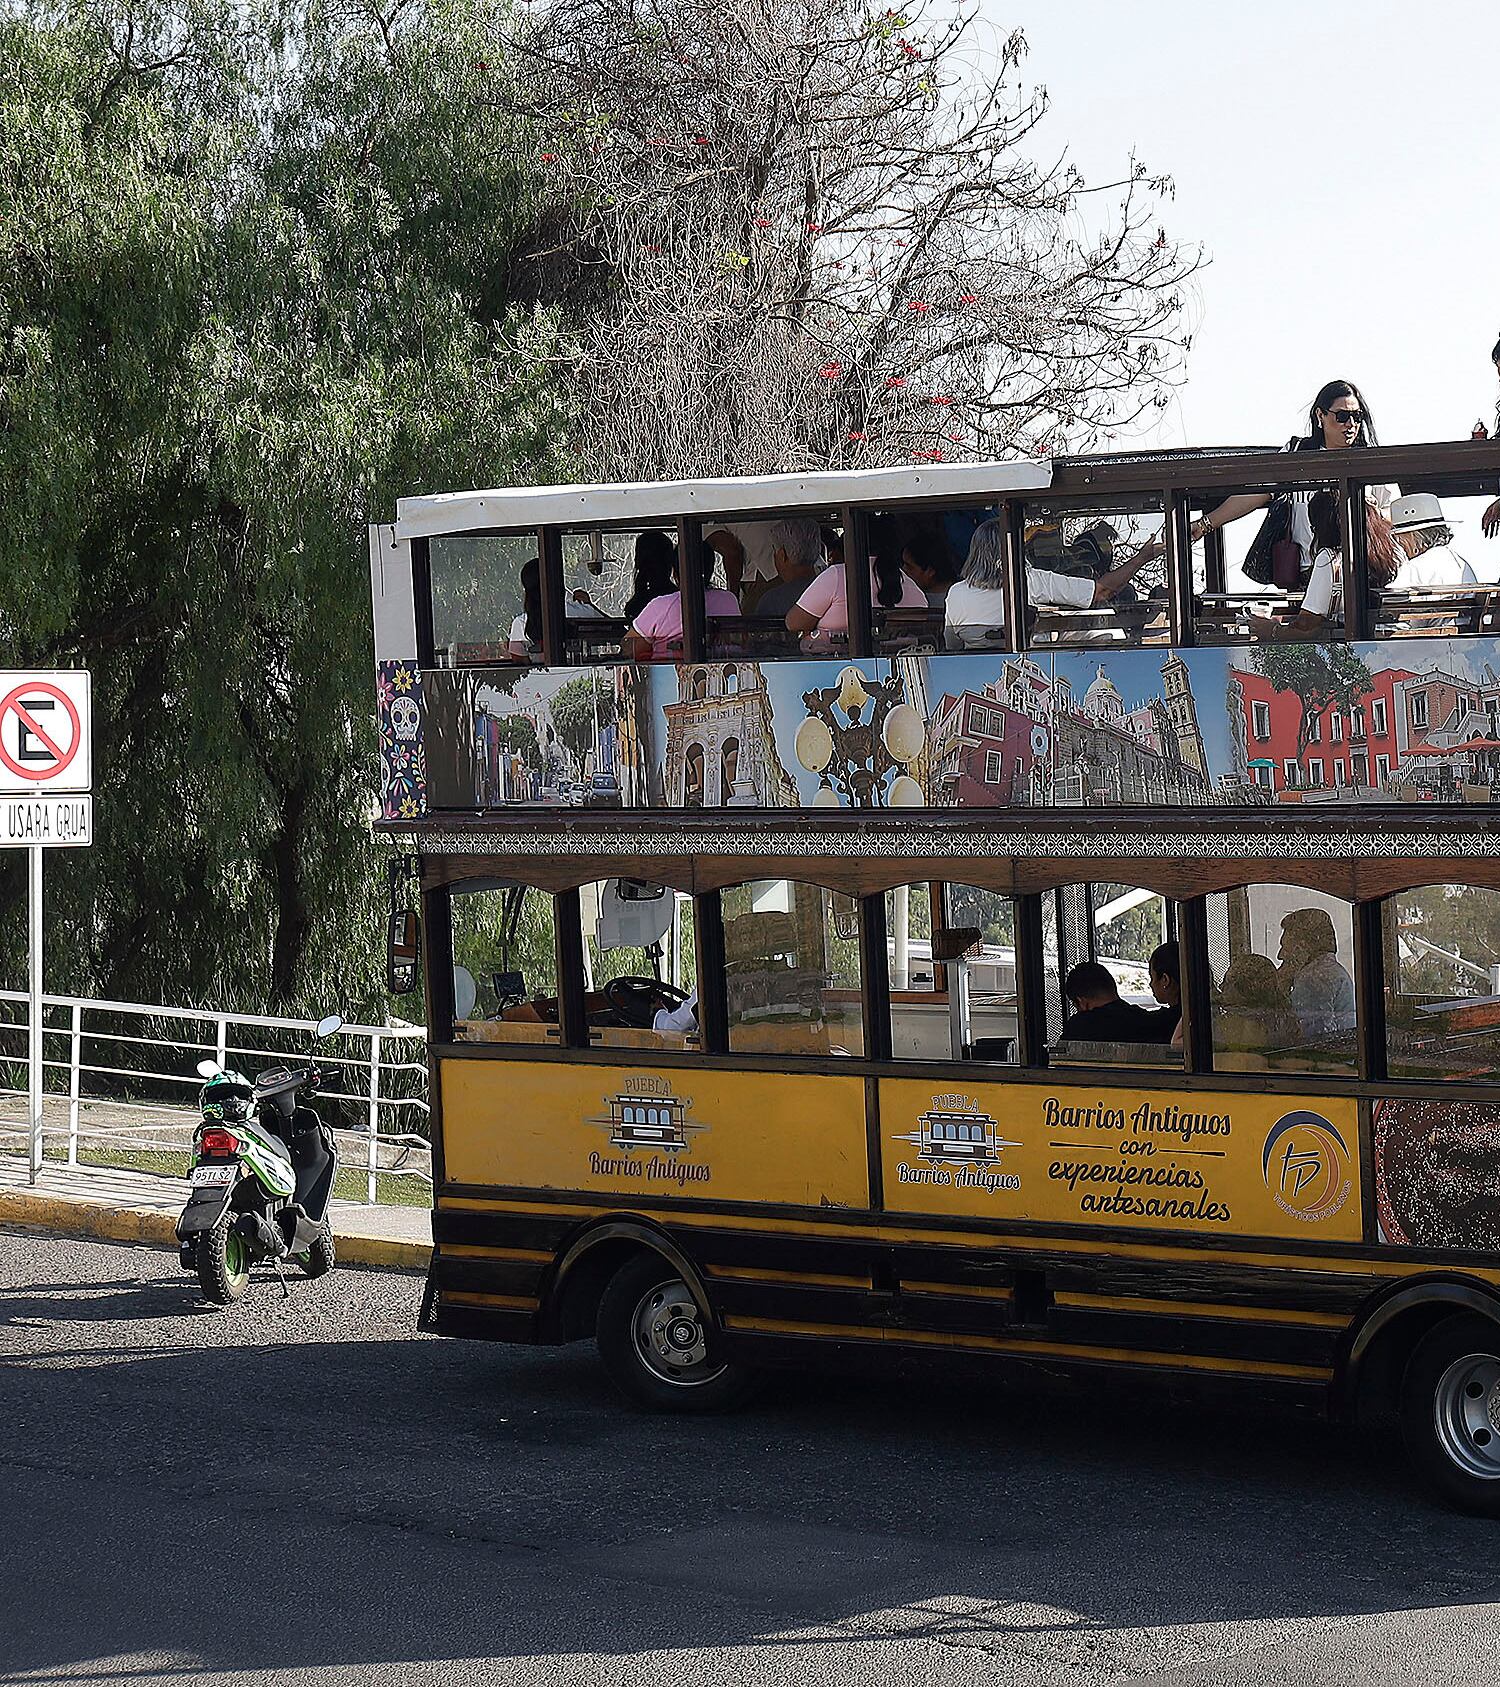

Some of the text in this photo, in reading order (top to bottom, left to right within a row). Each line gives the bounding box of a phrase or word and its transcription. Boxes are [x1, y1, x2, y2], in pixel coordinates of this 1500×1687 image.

[8, 803, 50, 838] USARA
[56, 803, 87, 838] GRUA
[624, 1078, 670, 1096] PUEBLA
[931, 1094, 979, 1112] PUEBLA
[1042, 1097, 1231, 1142] Barrios Antiguos
[1119, 1139, 1158, 1156] con
[588, 1151, 710, 1187] Barrios Antiguos
[897, 1162, 1021, 1194] Barrios Antiguos
[1048, 1159, 1205, 1191] experiencias
[1080, 1186, 1231, 1222] artesanales
[1319, 1180, 1352, 1220] POBLANOS
